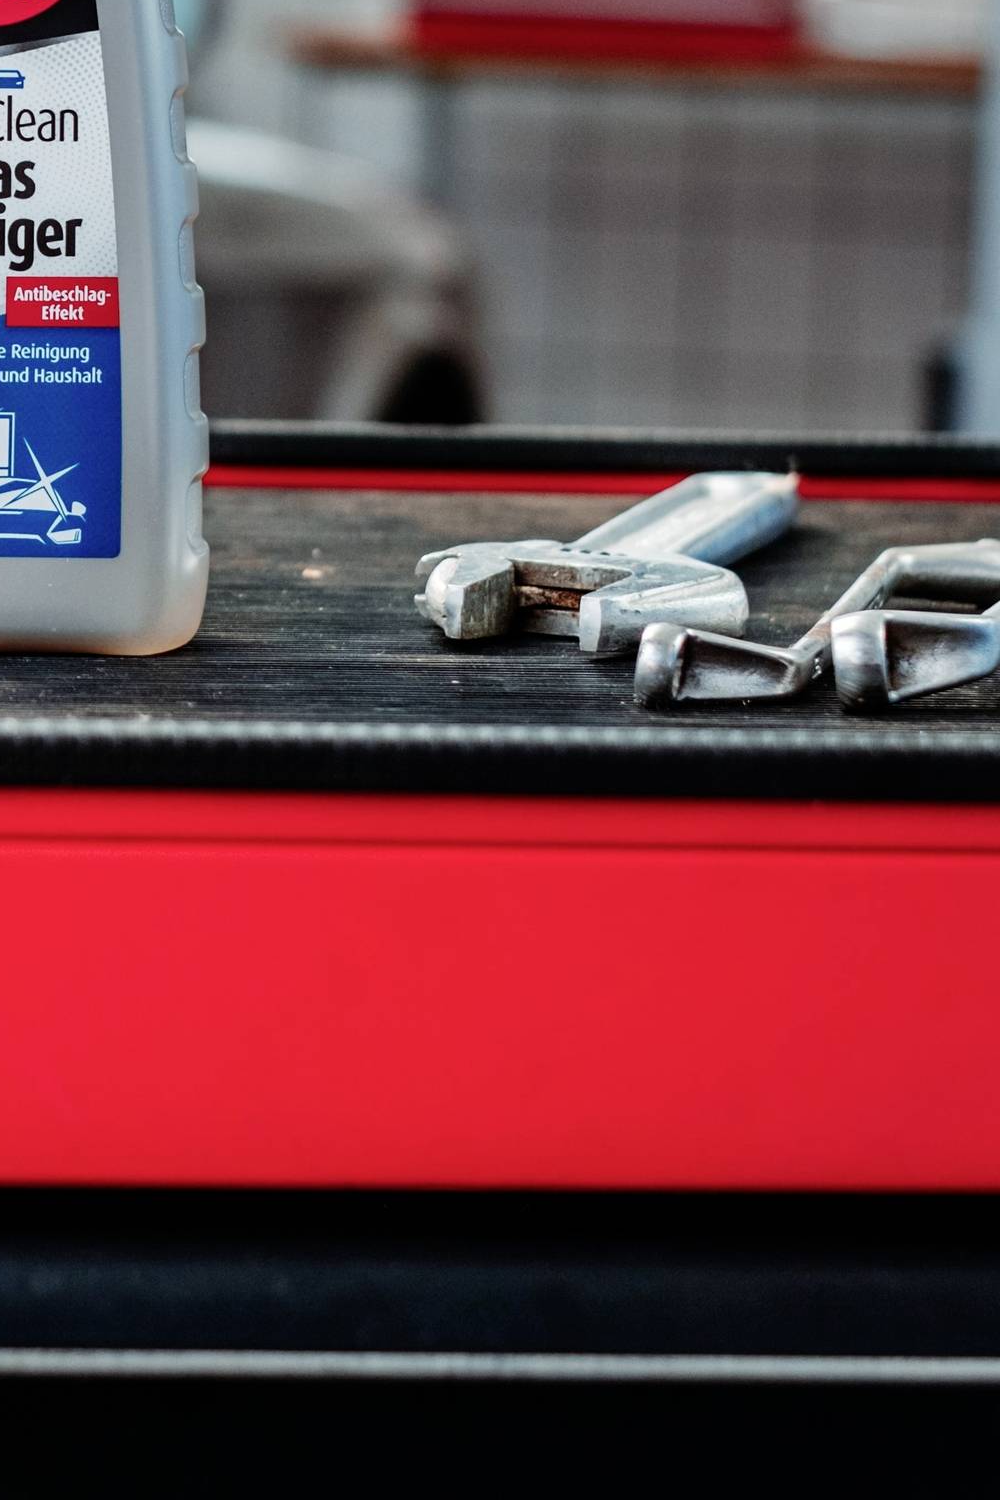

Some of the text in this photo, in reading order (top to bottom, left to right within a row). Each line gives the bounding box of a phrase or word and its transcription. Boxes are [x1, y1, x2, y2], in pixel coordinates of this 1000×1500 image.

[13, 285, 112, 306] Antibeschlag-
[41, 305, 85, 321] Effekt
[11, 343, 90, 363] Reinigung
[0, 368, 29, 383] und
[34, 368, 103, 384] Haushalt
